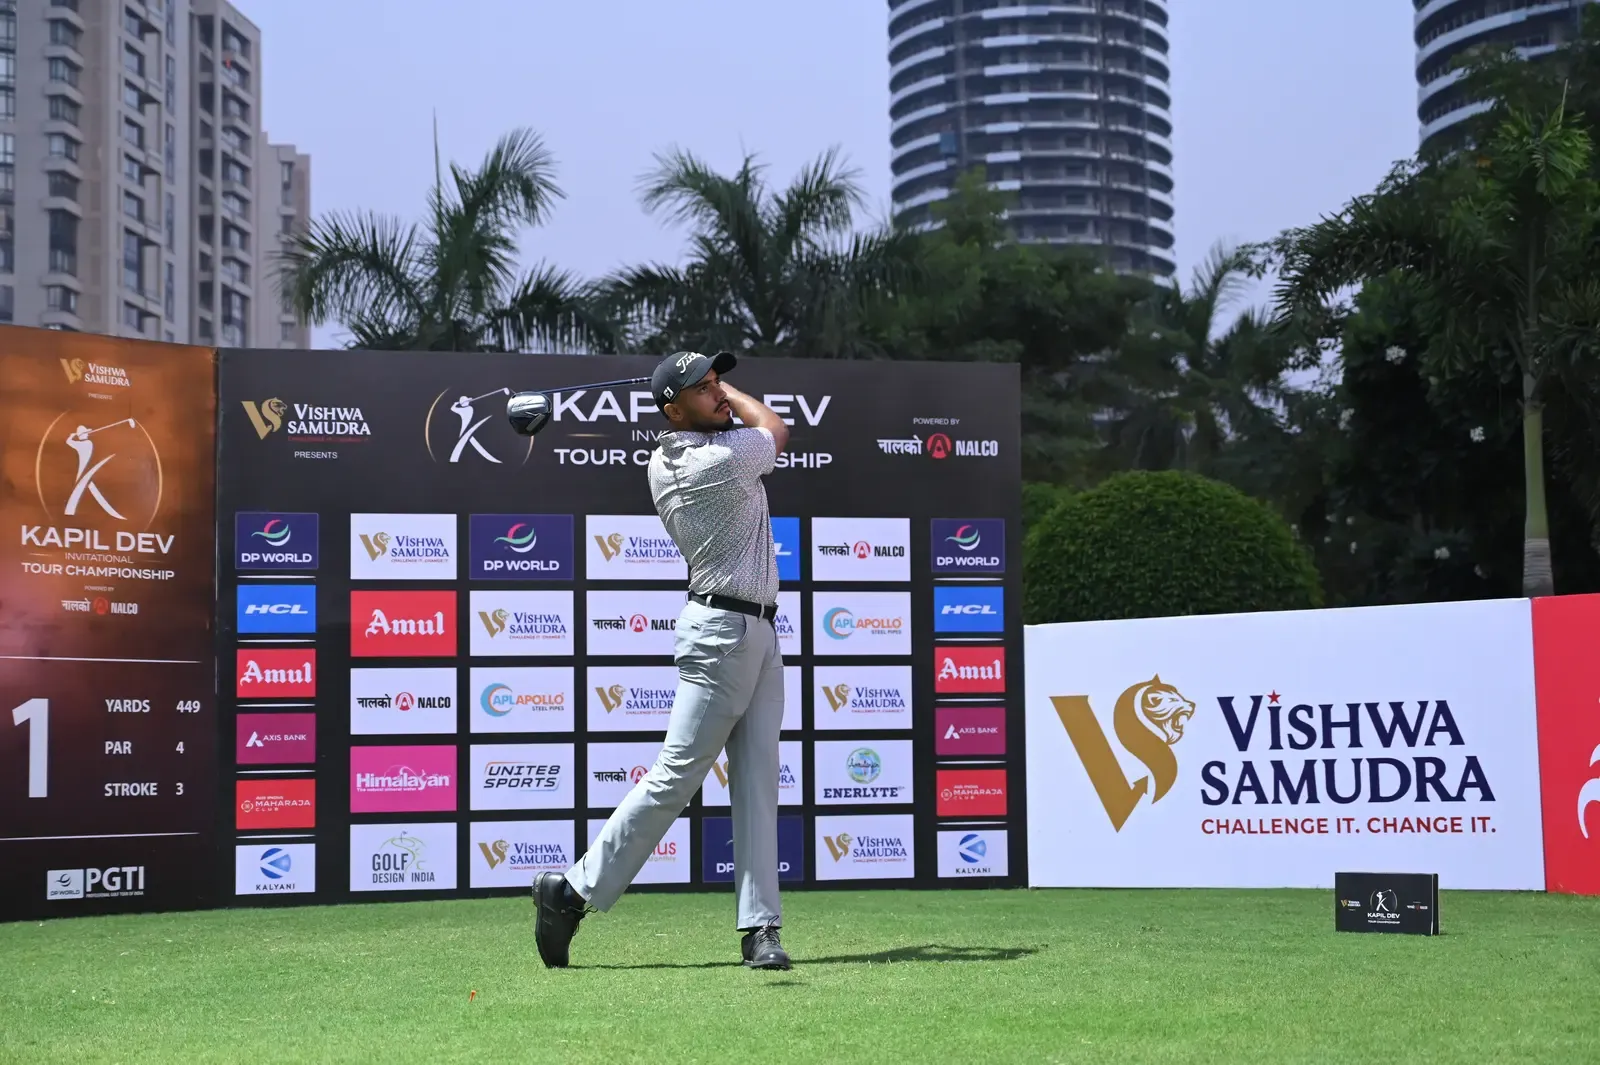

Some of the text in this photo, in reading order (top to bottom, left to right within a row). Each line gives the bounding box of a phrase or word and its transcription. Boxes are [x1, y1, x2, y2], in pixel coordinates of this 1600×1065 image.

[84, 373, 130, 387] SAMUDRA
[553, 390, 832, 427] KAP EV
[287, 420, 371, 435] SAMUDRA
[913, 417, 949, 425] POWERED
[877, 434, 923, 455] नालको
[955, 440, 999, 456] NALCO
[294, 451, 338, 459] PRESENTS
[553, 448, 627, 465] TOUR
[21, 525, 175, 554] KAPIL DEV
[391, 548, 449, 557] SAMUDRA
[624, 549, 681, 558] SAMUDRA
[818, 542, 850, 556] नालको
[874, 546, 905, 557] NALCO
[65, 552, 134, 564] INVITATIONAL
[241, 553, 312, 563] DP WORLD
[936, 556, 999, 566] DP WORLD
[21, 562, 175, 580] TOUR CHAMPIONSHIP
[484, 560, 560, 571] DP WORLD
[61, 597, 91, 612] नालको
[111, 602, 138, 615] NALCO
[245, 604, 308, 614] HCL
[941, 604, 997, 614] HCL
[365, 608, 445, 638] Amul
[509, 624, 567, 634] SAMUDRA
[592, 616, 626, 630] नालको
[651, 619, 677, 631] NALC
[240, 659, 312, 686] Amul
[938, 657, 1001, 681] Amul
[105, 699, 201, 713] YARDS 449
[356, 694, 391, 709] नालको
[417, 697, 451, 708] NALCO
[626, 700, 673, 709] SAMUDR
[851, 699, 905, 708] SAMUDRA
[12, 698, 49, 798] 1
[105, 741, 185, 754] PAR 4
[356, 768, 450, 791] Himalayan
[593, 768, 627, 782] नालको
[1200, 755, 1496, 806] SAMUDRA
[104, 782, 184, 797] STROKE 3
[483, 777, 557, 789] SPORTS
[823, 787, 899, 799] ENERLYTE
[953, 788, 1003, 796] MAHARAJA
[255, 799, 311, 807] MAHARAJA
[1201, 816, 1497, 835] CHALLENGE IT. CHANGE IT.
[509, 854, 568, 864] SAMUDRA
[853, 848, 907, 858] SAMUDRA
[372, 853, 408, 871] GOLF
[716, 862, 735, 873] DP
[86, 866, 144, 892] PGTI
[372, 871, 435, 884] DESIGN INDIA
[255, 883, 295, 891] KALYANI
